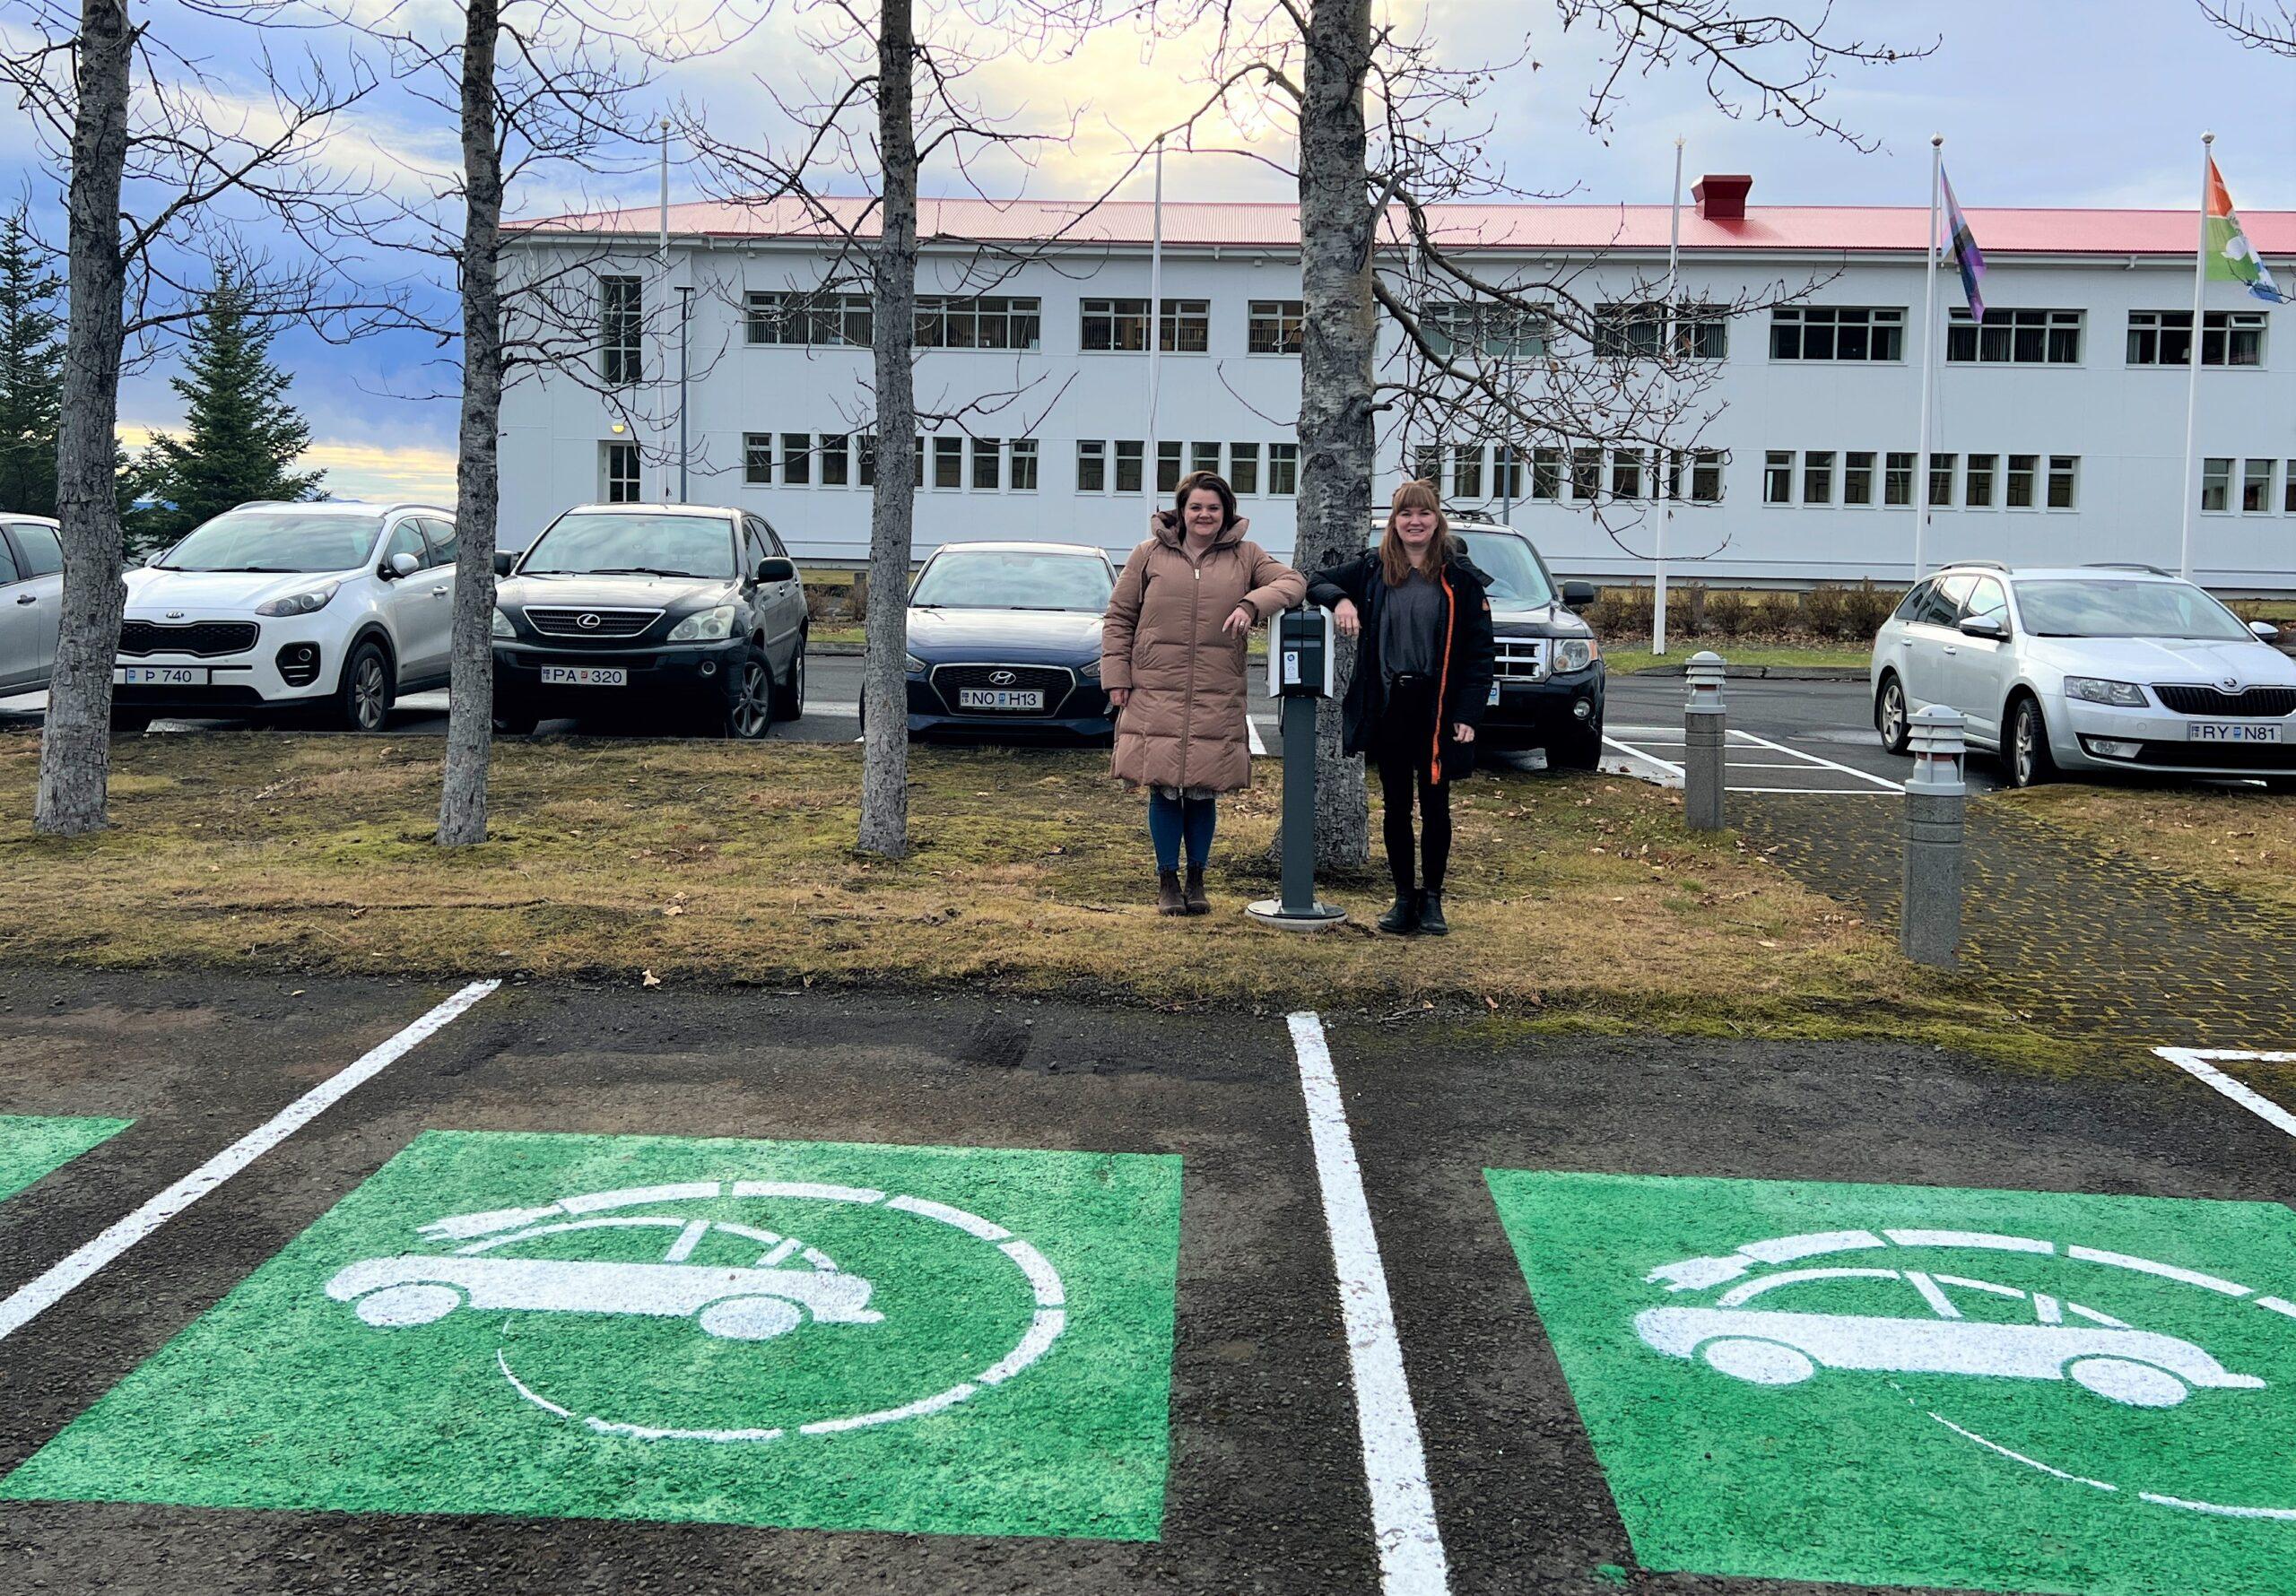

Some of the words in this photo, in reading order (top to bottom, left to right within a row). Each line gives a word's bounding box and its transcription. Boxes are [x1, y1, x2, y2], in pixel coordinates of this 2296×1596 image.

[145, 670, 155, 681] Þ
[162, 670, 191, 682] 740
[553, 669, 577, 682] PA
[592, 670, 622, 683] 320
[972, 691, 995, 705] NO
[1009, 692, 1037, 706] H13
[2203, 725, 2229, 739] RY
[2244, 726, 2274, 741] N81
